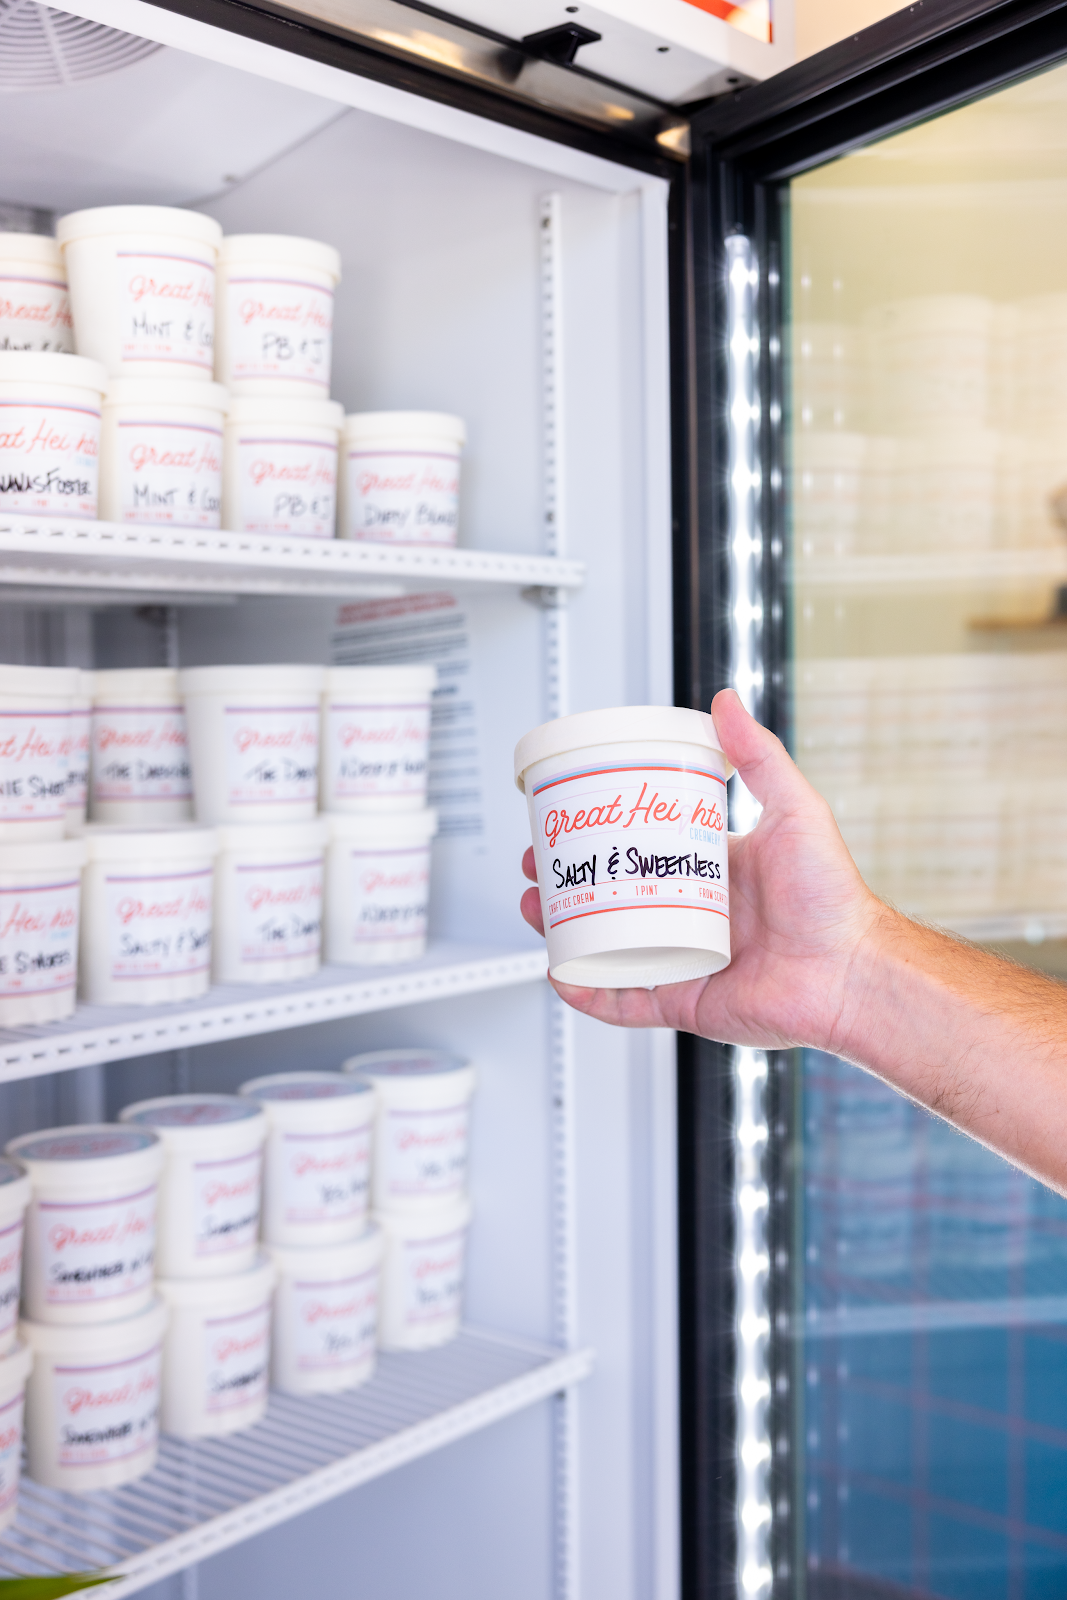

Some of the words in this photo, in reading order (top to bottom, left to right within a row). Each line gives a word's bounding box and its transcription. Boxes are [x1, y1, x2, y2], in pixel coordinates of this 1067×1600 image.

[0, 300, 51, 324] reat
[545, 795, 623, 848] Great
[689, 826, 721, 847] CREAMERY
[552, 854, 597, 889] SALTY
[625, 847, 721, 880] SWEETNESS
[562, 896, 571, 909] ICE
[572, 891, 595, 906] CREAM
[641, 884, 659, 896] PINT
[699, 887, 713, 900] FROM
